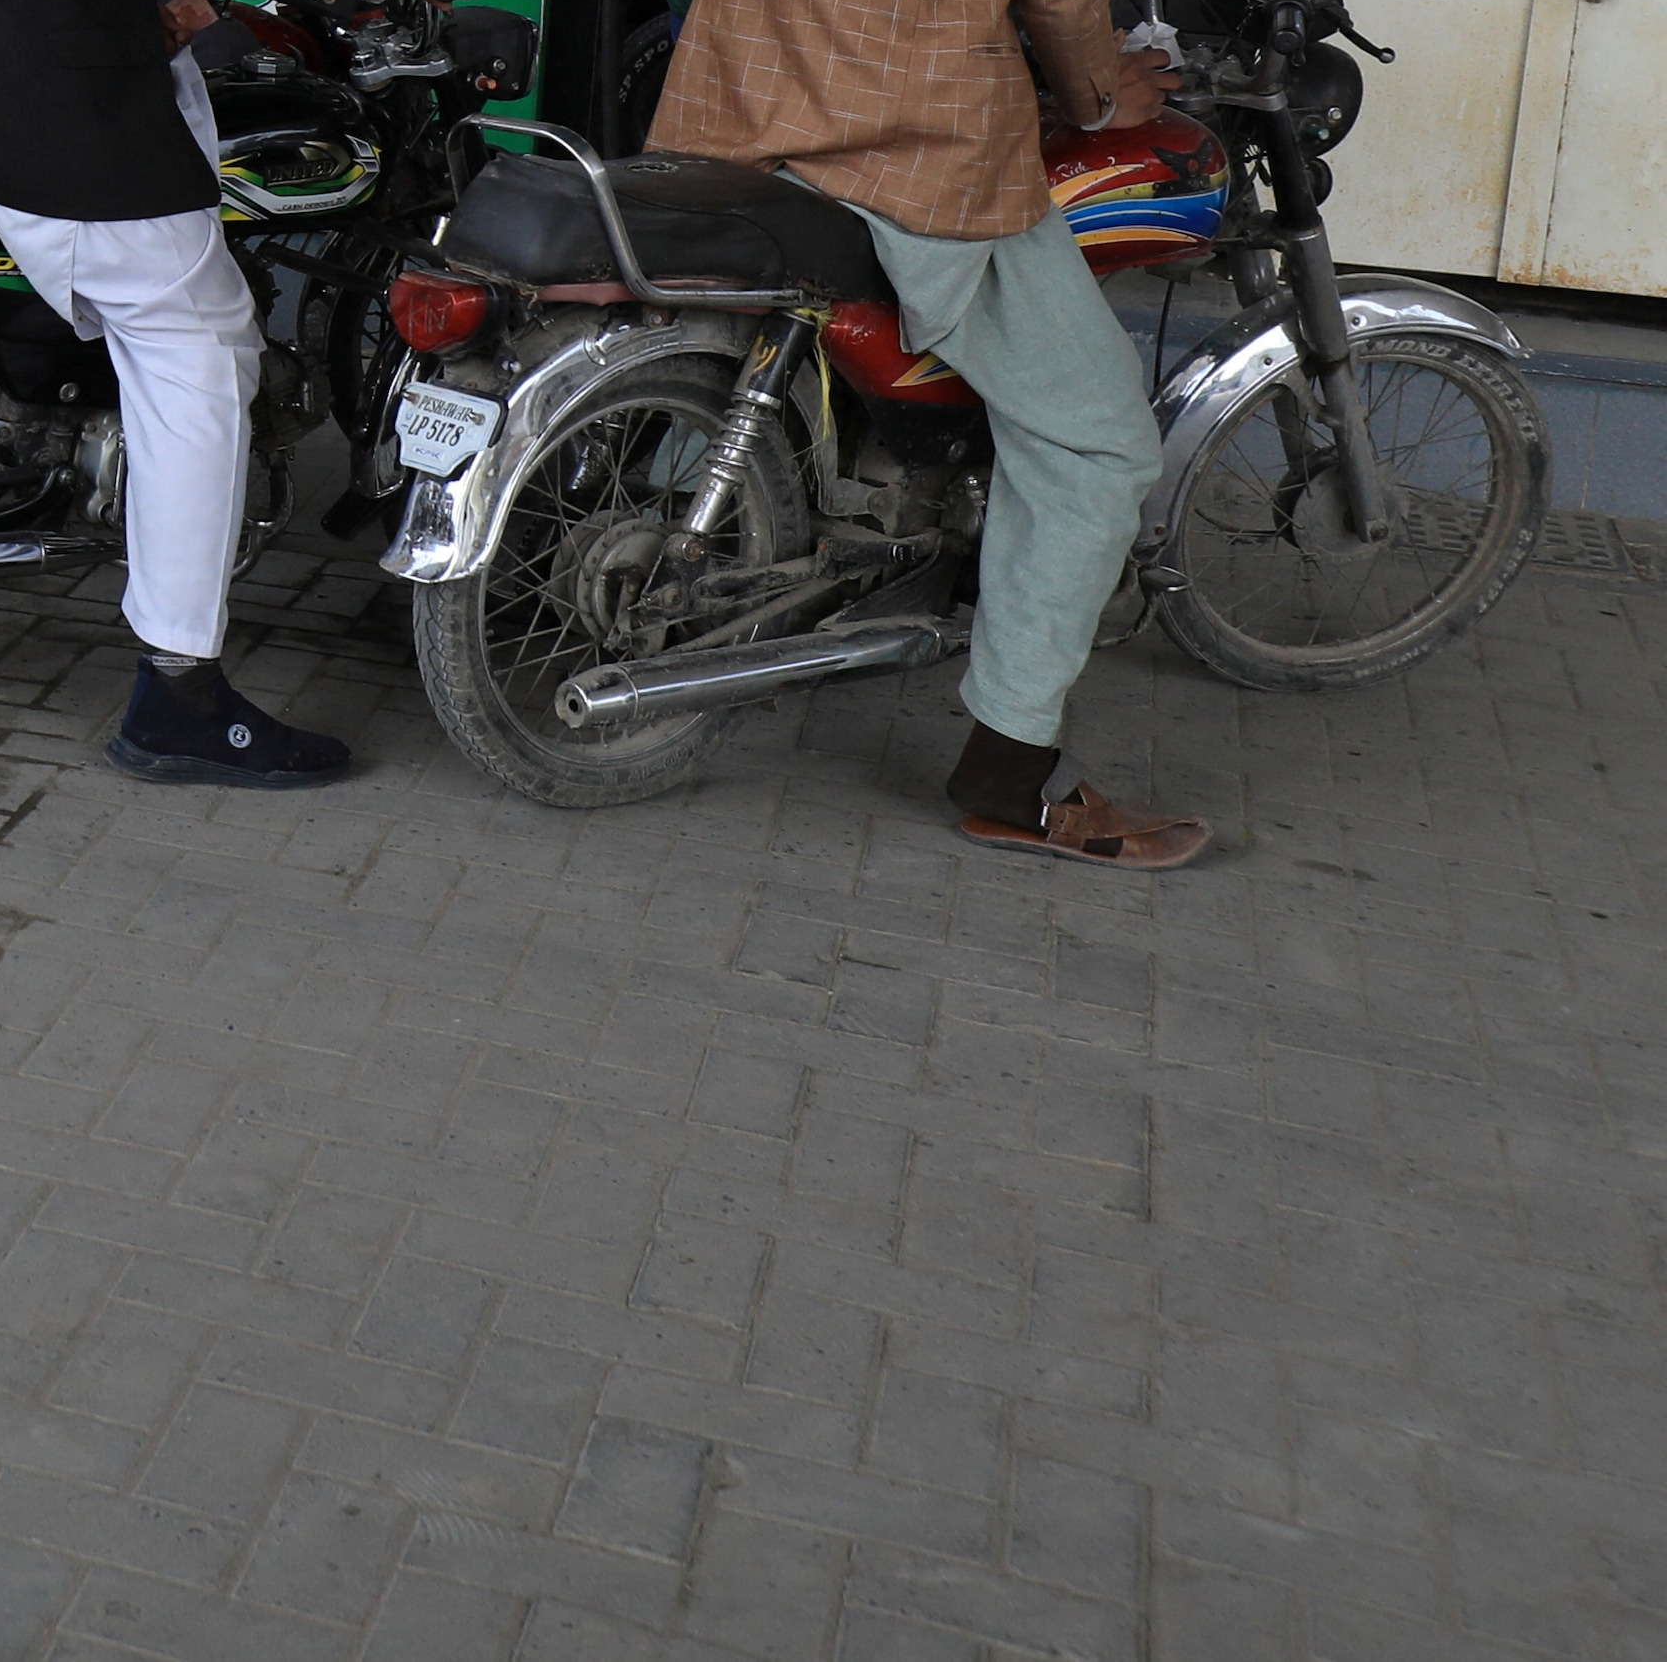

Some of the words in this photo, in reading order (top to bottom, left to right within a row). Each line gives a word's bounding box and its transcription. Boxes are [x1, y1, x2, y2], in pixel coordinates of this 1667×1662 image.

[418, 395, 474, 422] PESHAWAR
[408, 415, 429, 436] LP
[426, 421, 465, 447] 5178
